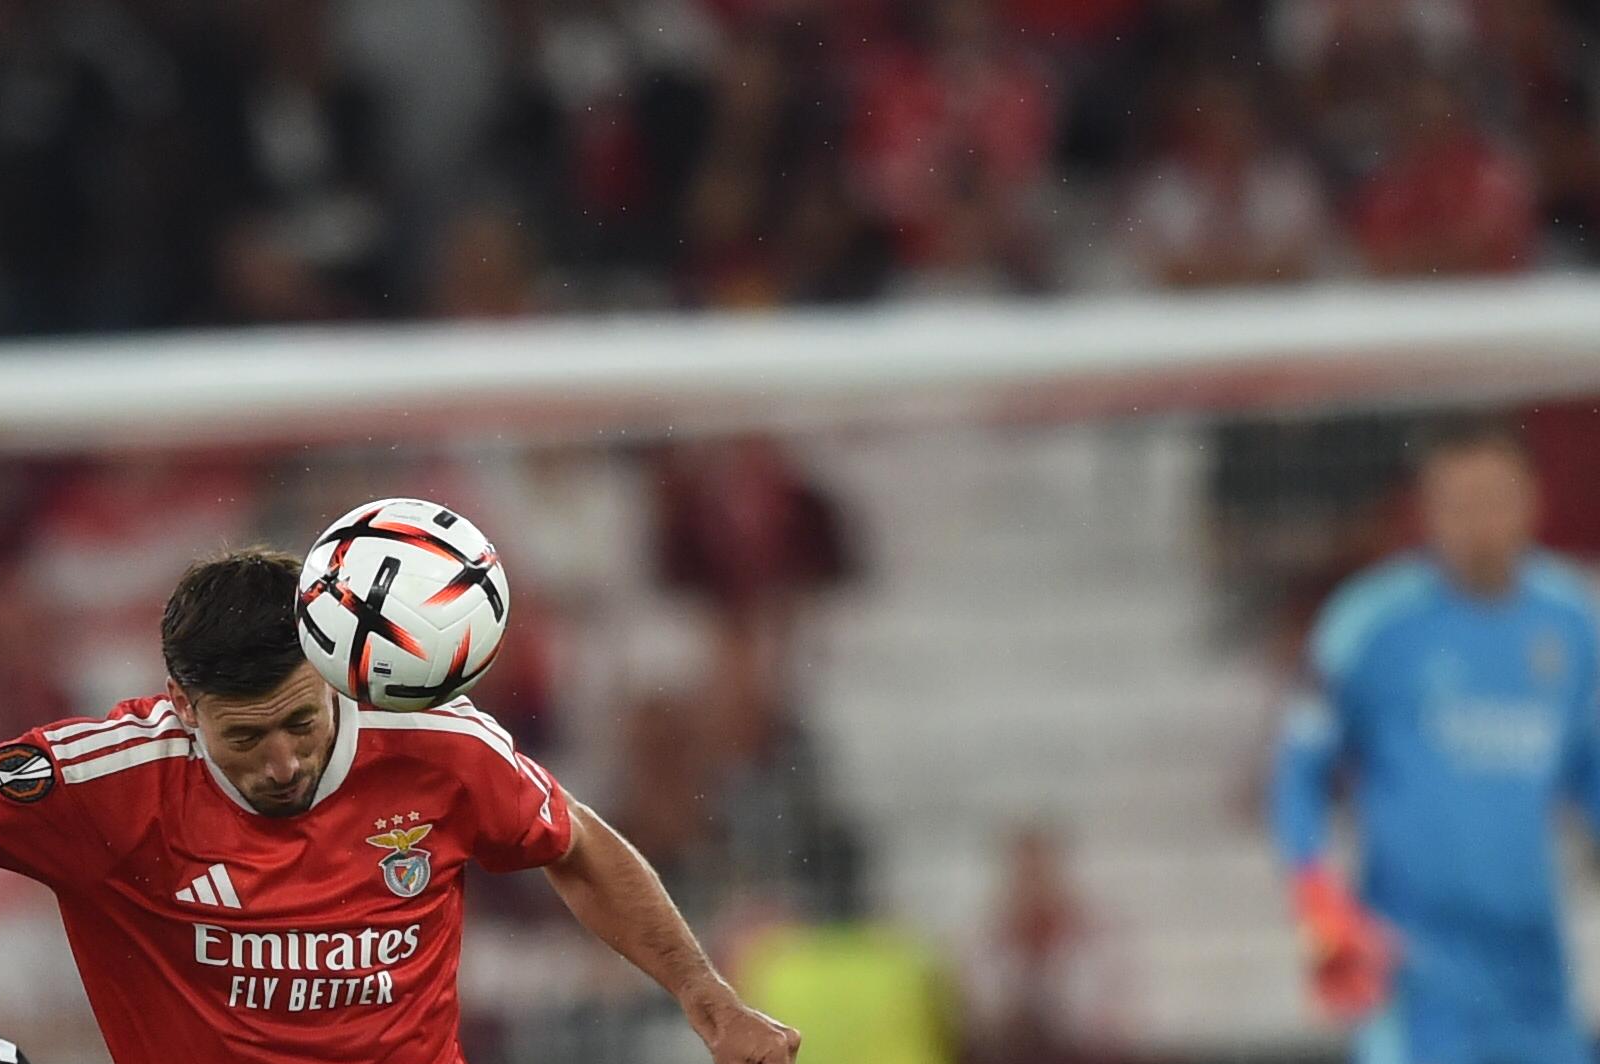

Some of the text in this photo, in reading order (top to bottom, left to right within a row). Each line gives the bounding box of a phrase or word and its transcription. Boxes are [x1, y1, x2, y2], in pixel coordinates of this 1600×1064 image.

[193, 923, 420, 971] Emirates
[229, 970, 393, 1012] FLY BETTER
